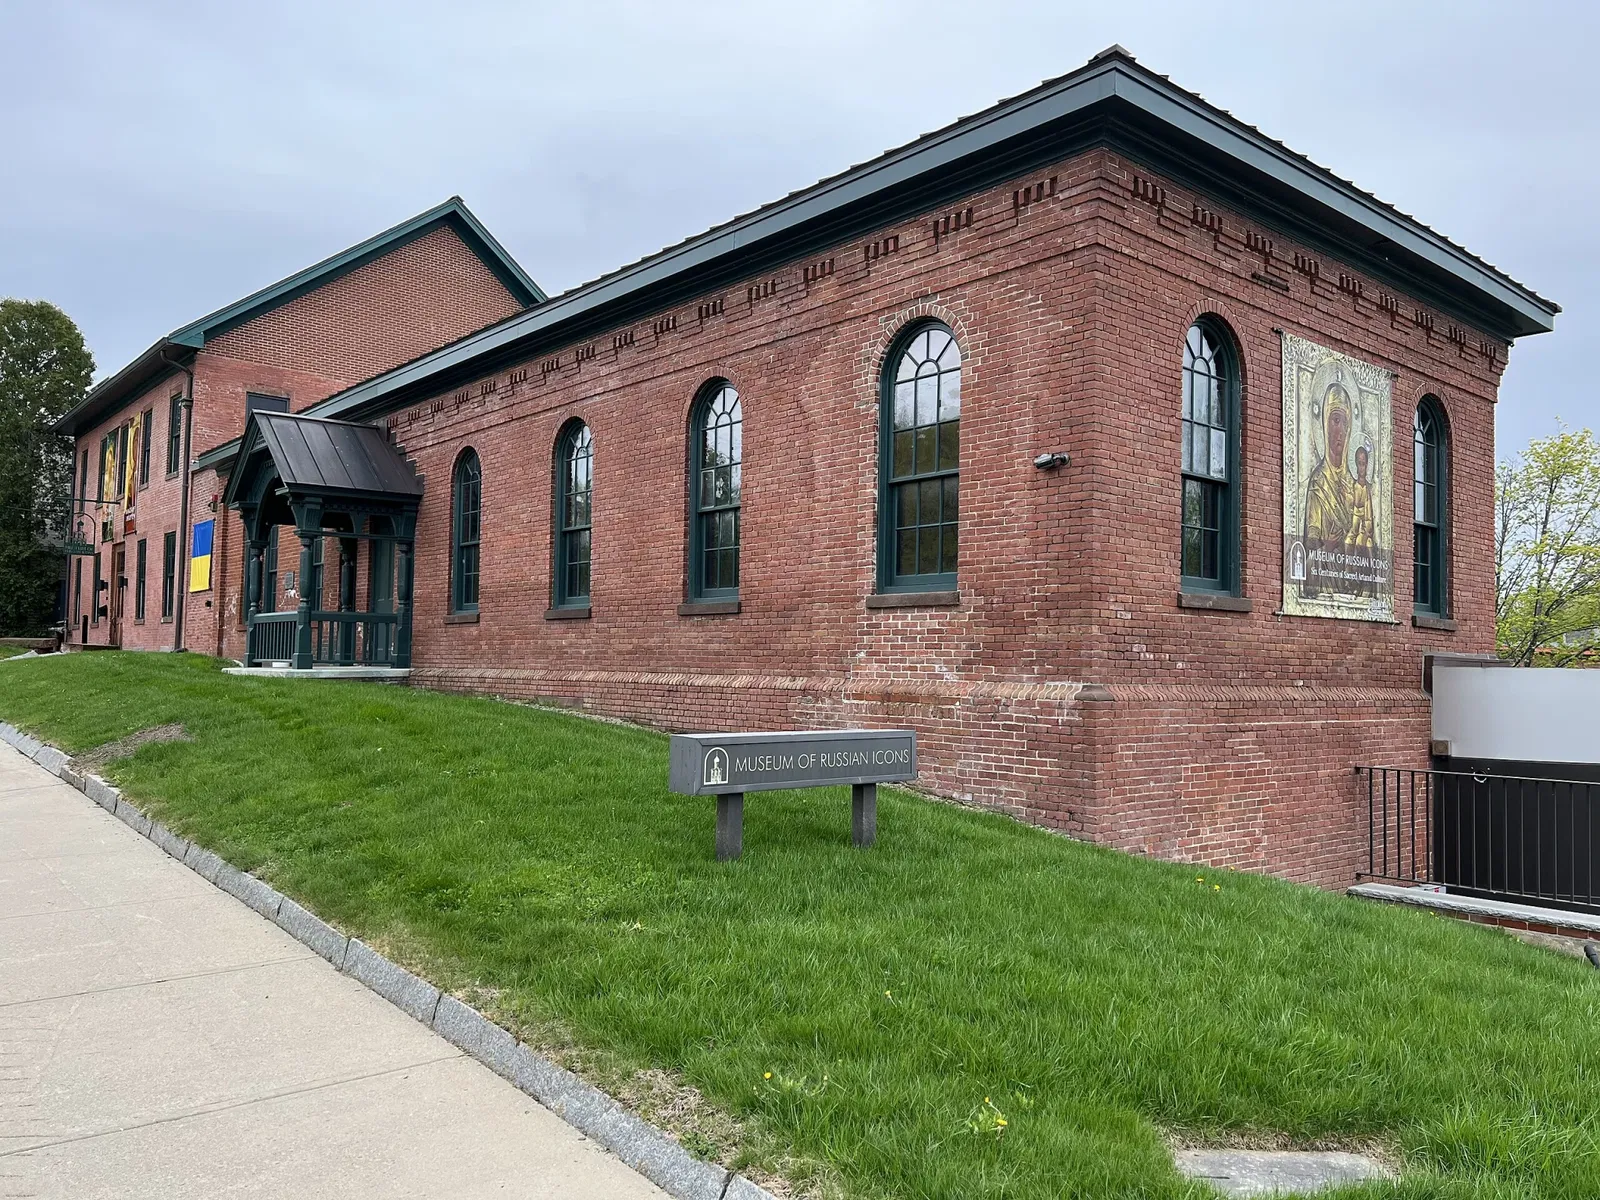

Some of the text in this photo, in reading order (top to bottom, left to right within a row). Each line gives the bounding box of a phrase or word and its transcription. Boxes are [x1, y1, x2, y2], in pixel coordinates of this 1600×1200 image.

[1309, 550, 1389, 570] MUSEUM OF RUSSIAN ICONS
[1318, 568, 1339, 577] Centuries
[1344, 570, 1358, 580] Sacred
[735, 749, 910, 772] MUSEUM OF RUSSIAN ICONS
